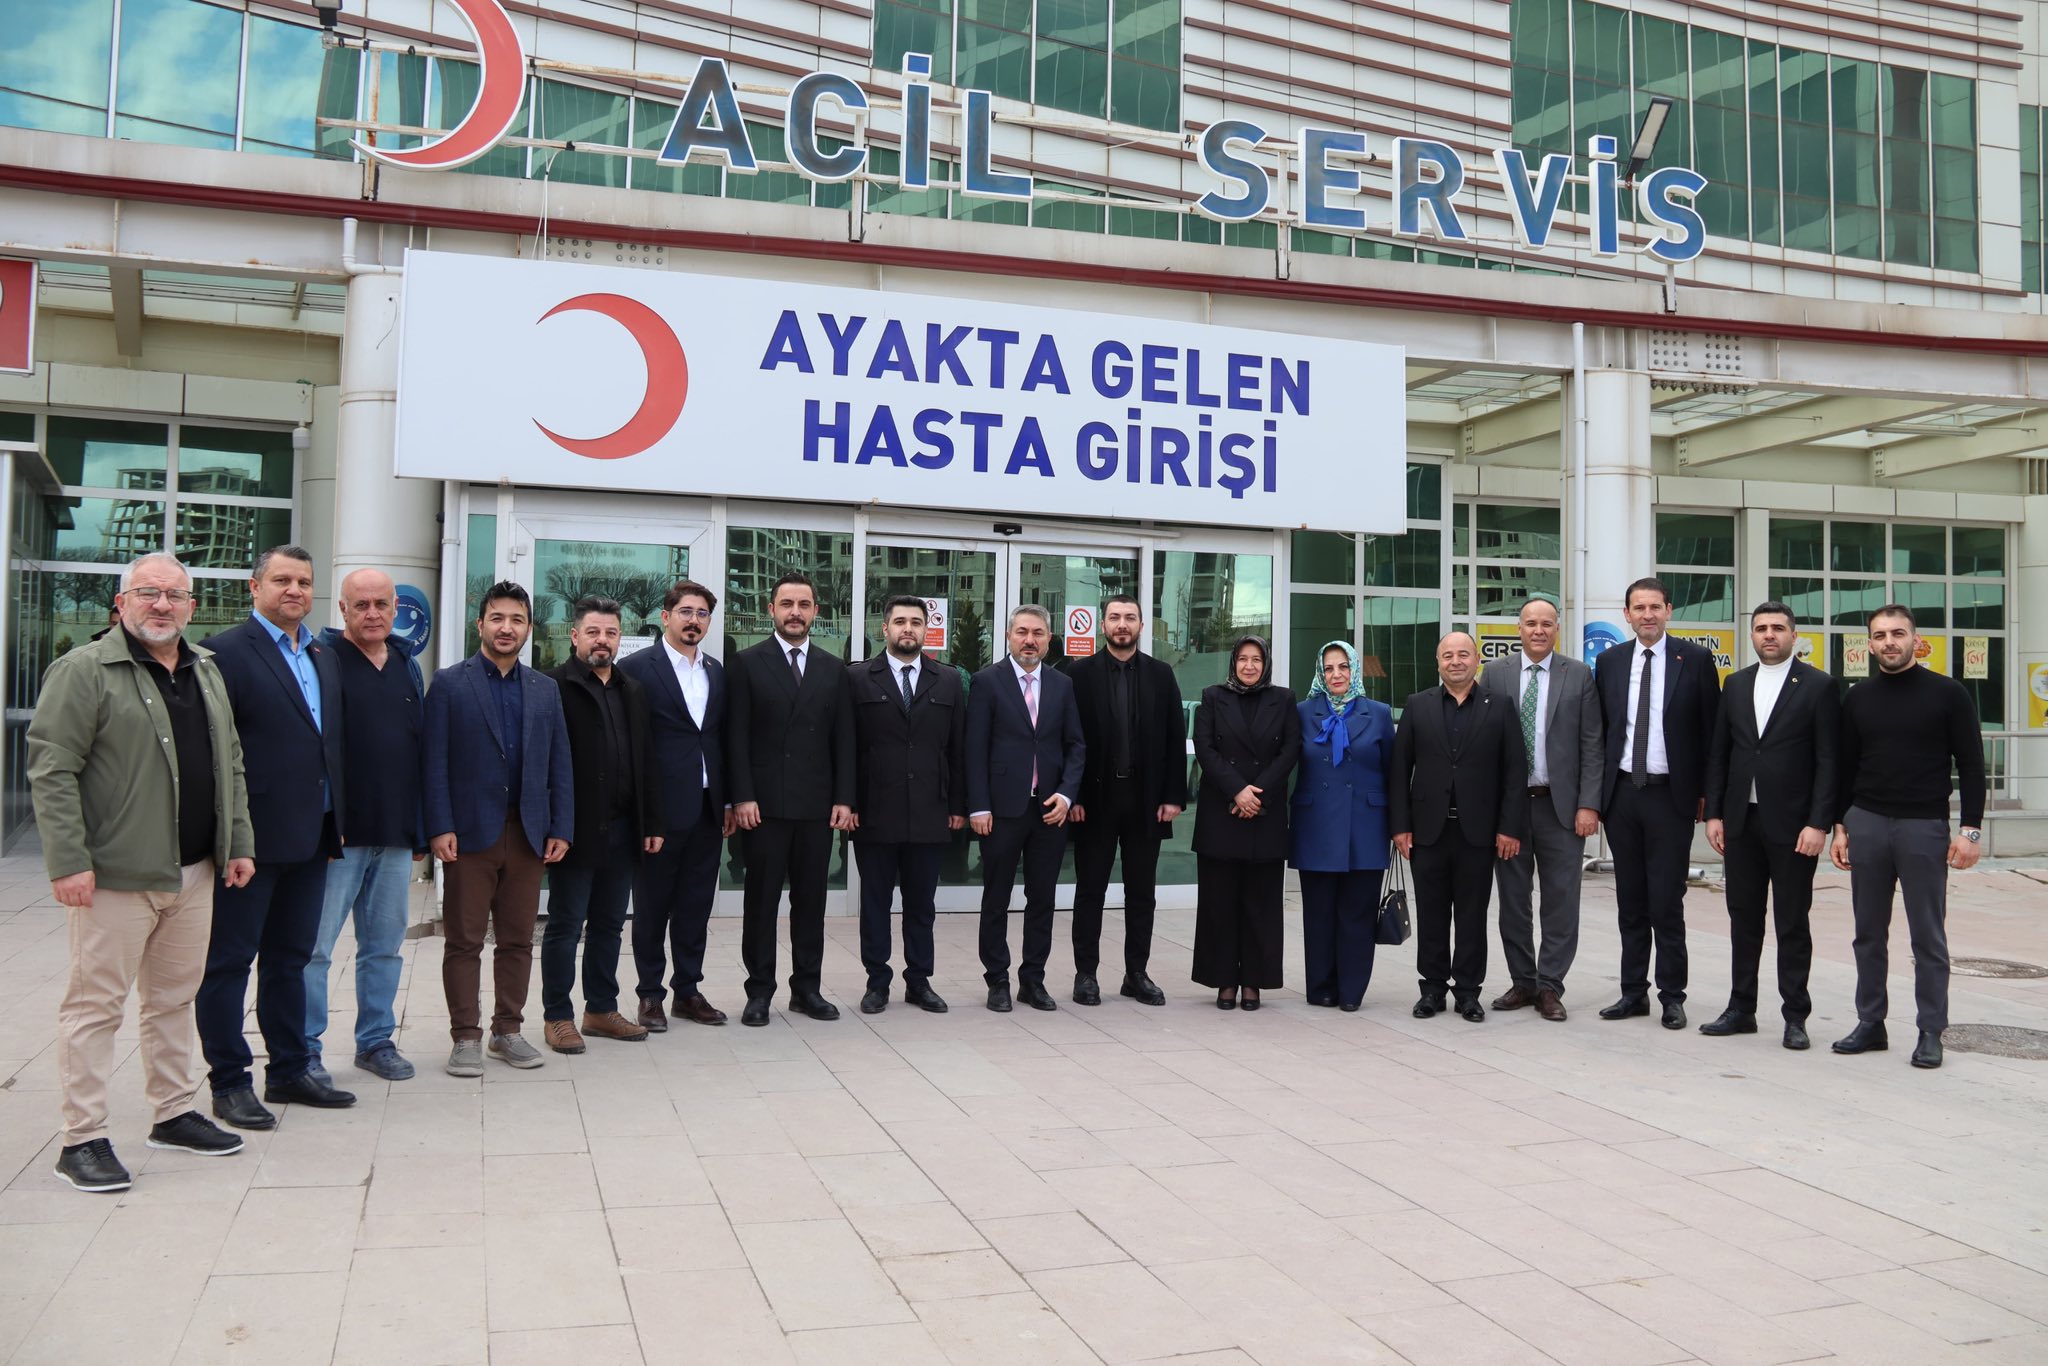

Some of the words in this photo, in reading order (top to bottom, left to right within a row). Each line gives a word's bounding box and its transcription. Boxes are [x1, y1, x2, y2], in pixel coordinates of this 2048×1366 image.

[656, 52, 1034, 203] ACİL
[1197, 119, 1708, 265] SERVİS
[761, 311, 1070, 395] AYAKTA
[1092, 341, 1310, 416] GELEN
[804, 400, 1055, 477] HASTA
[1077, 408, 1277, 499] GİRİŞİ
